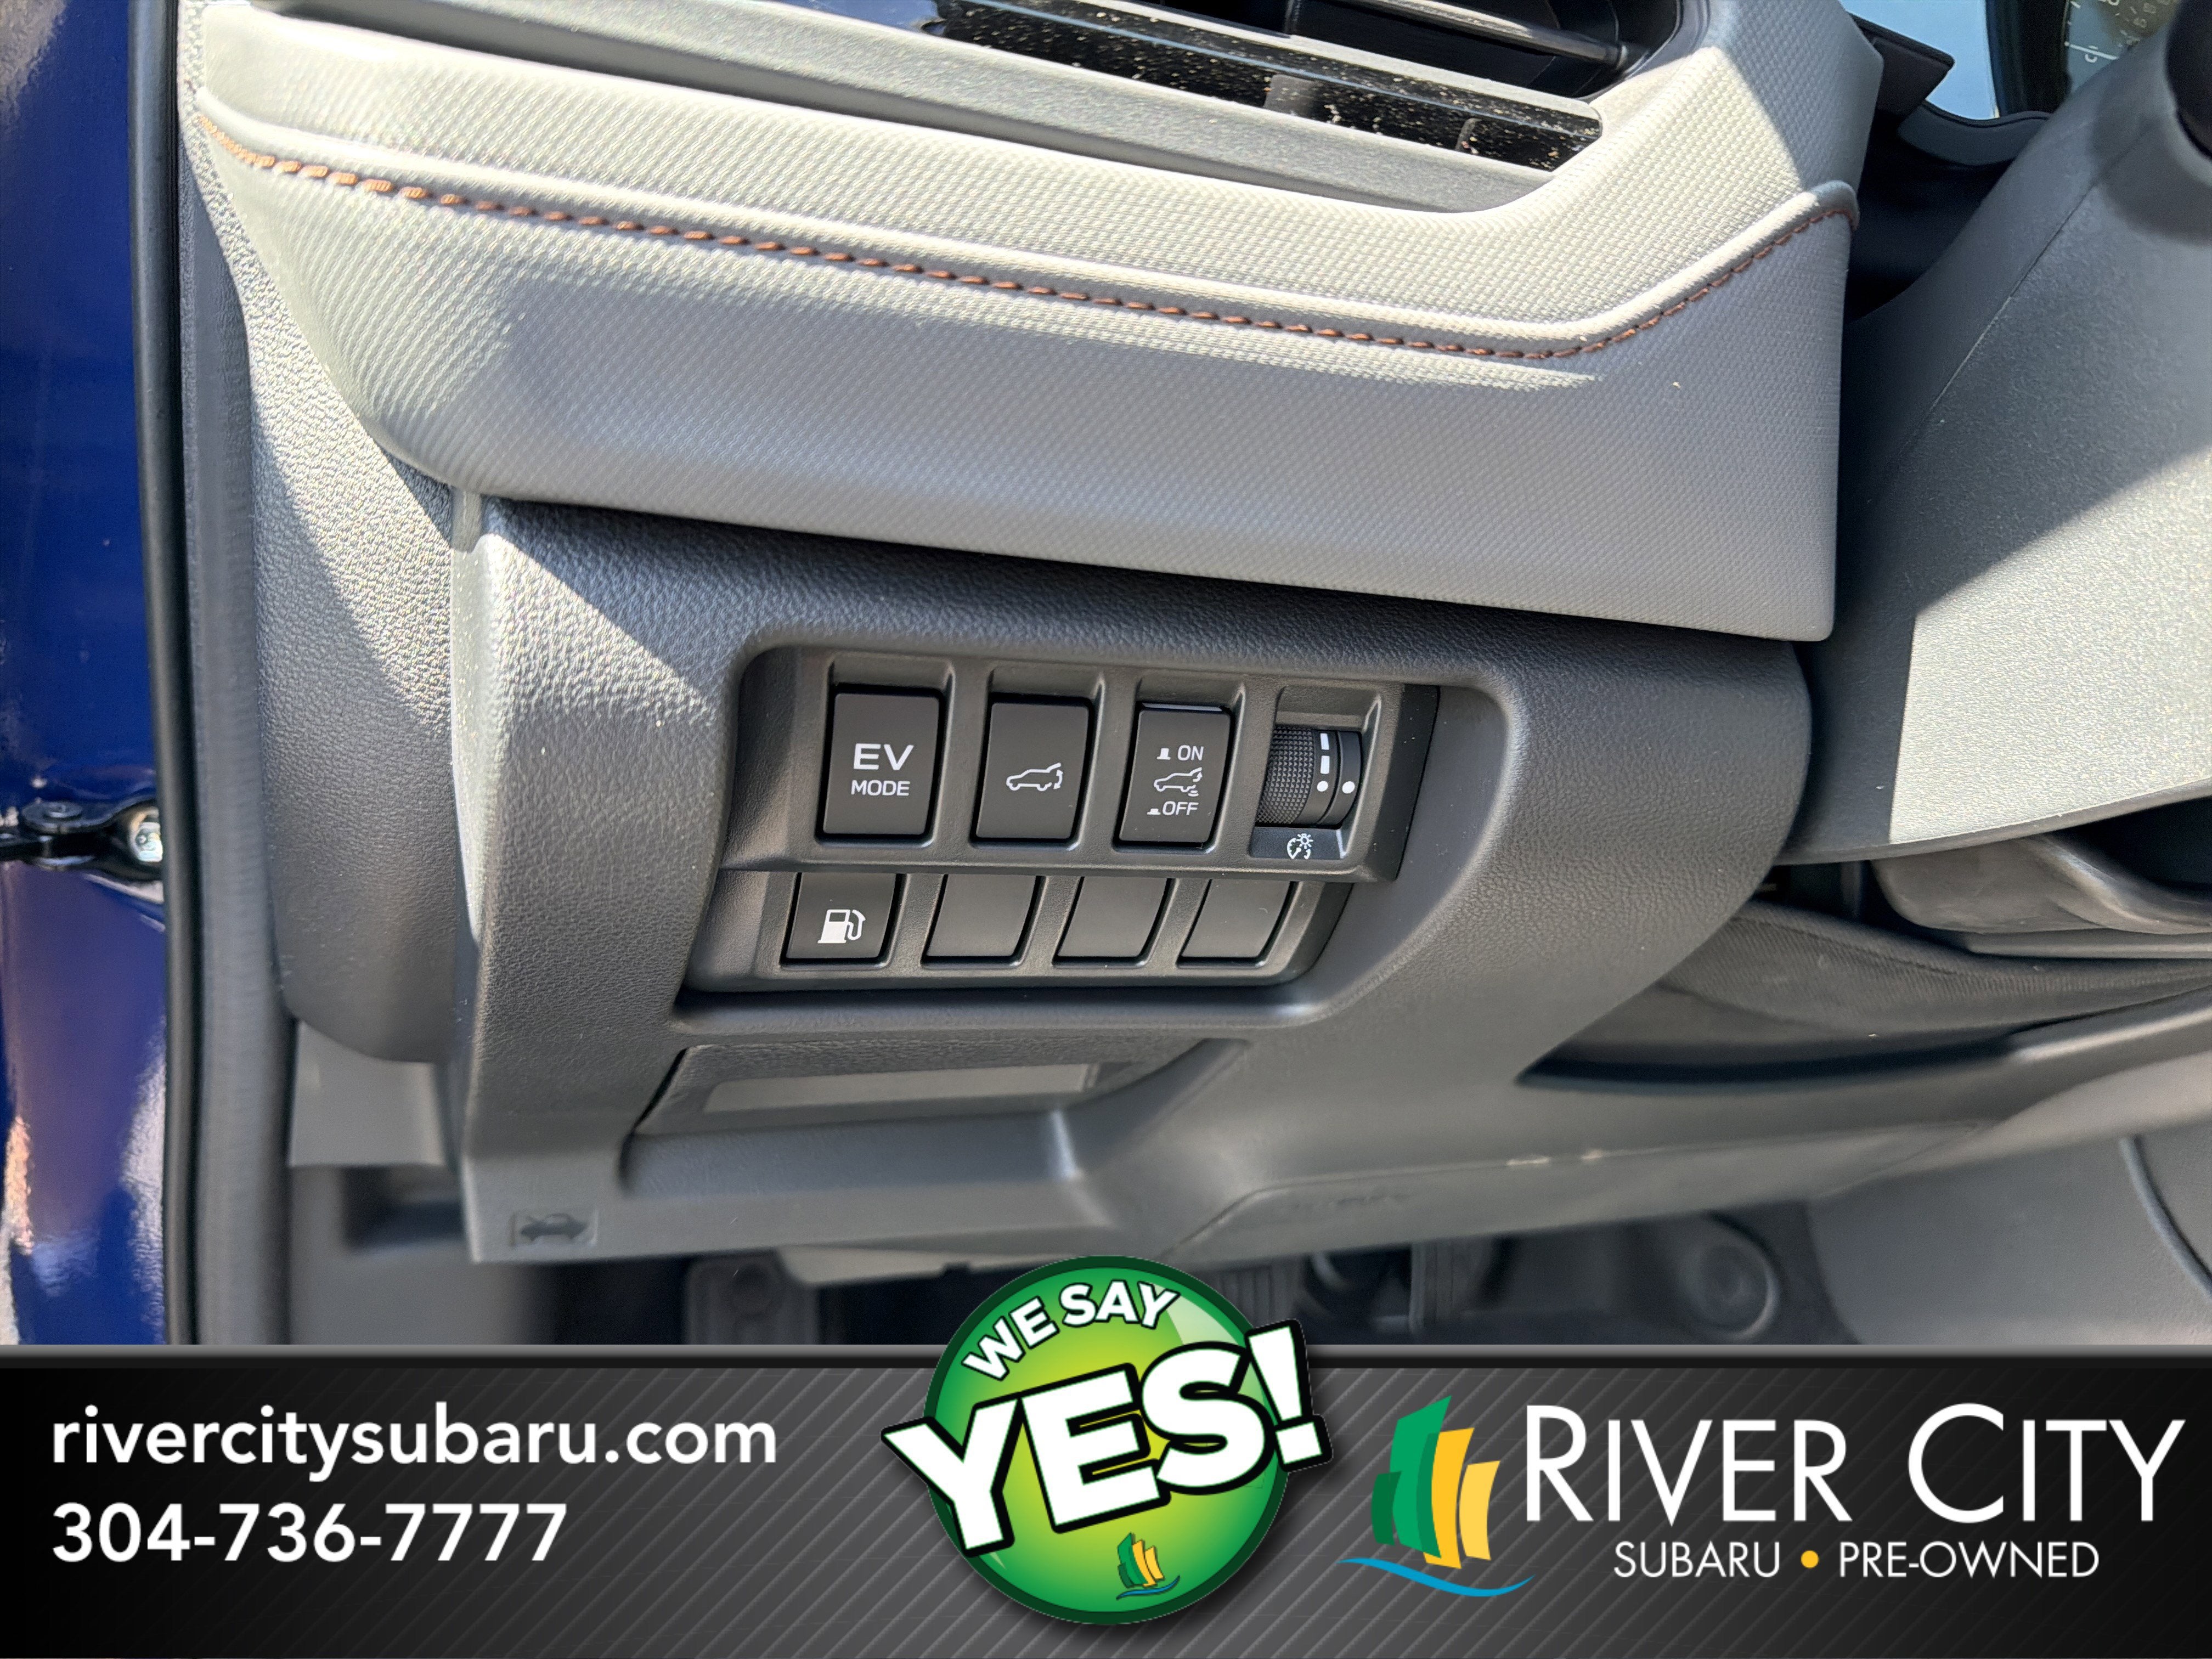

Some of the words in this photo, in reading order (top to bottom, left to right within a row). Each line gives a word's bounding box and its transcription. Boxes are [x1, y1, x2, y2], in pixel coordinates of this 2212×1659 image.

[853, 743, 915, 771] EV
[1177, 744, 1204, 761] ON
[851, 780, 911, 796] MODE
[1162, 800, 1199, 816] OFF
